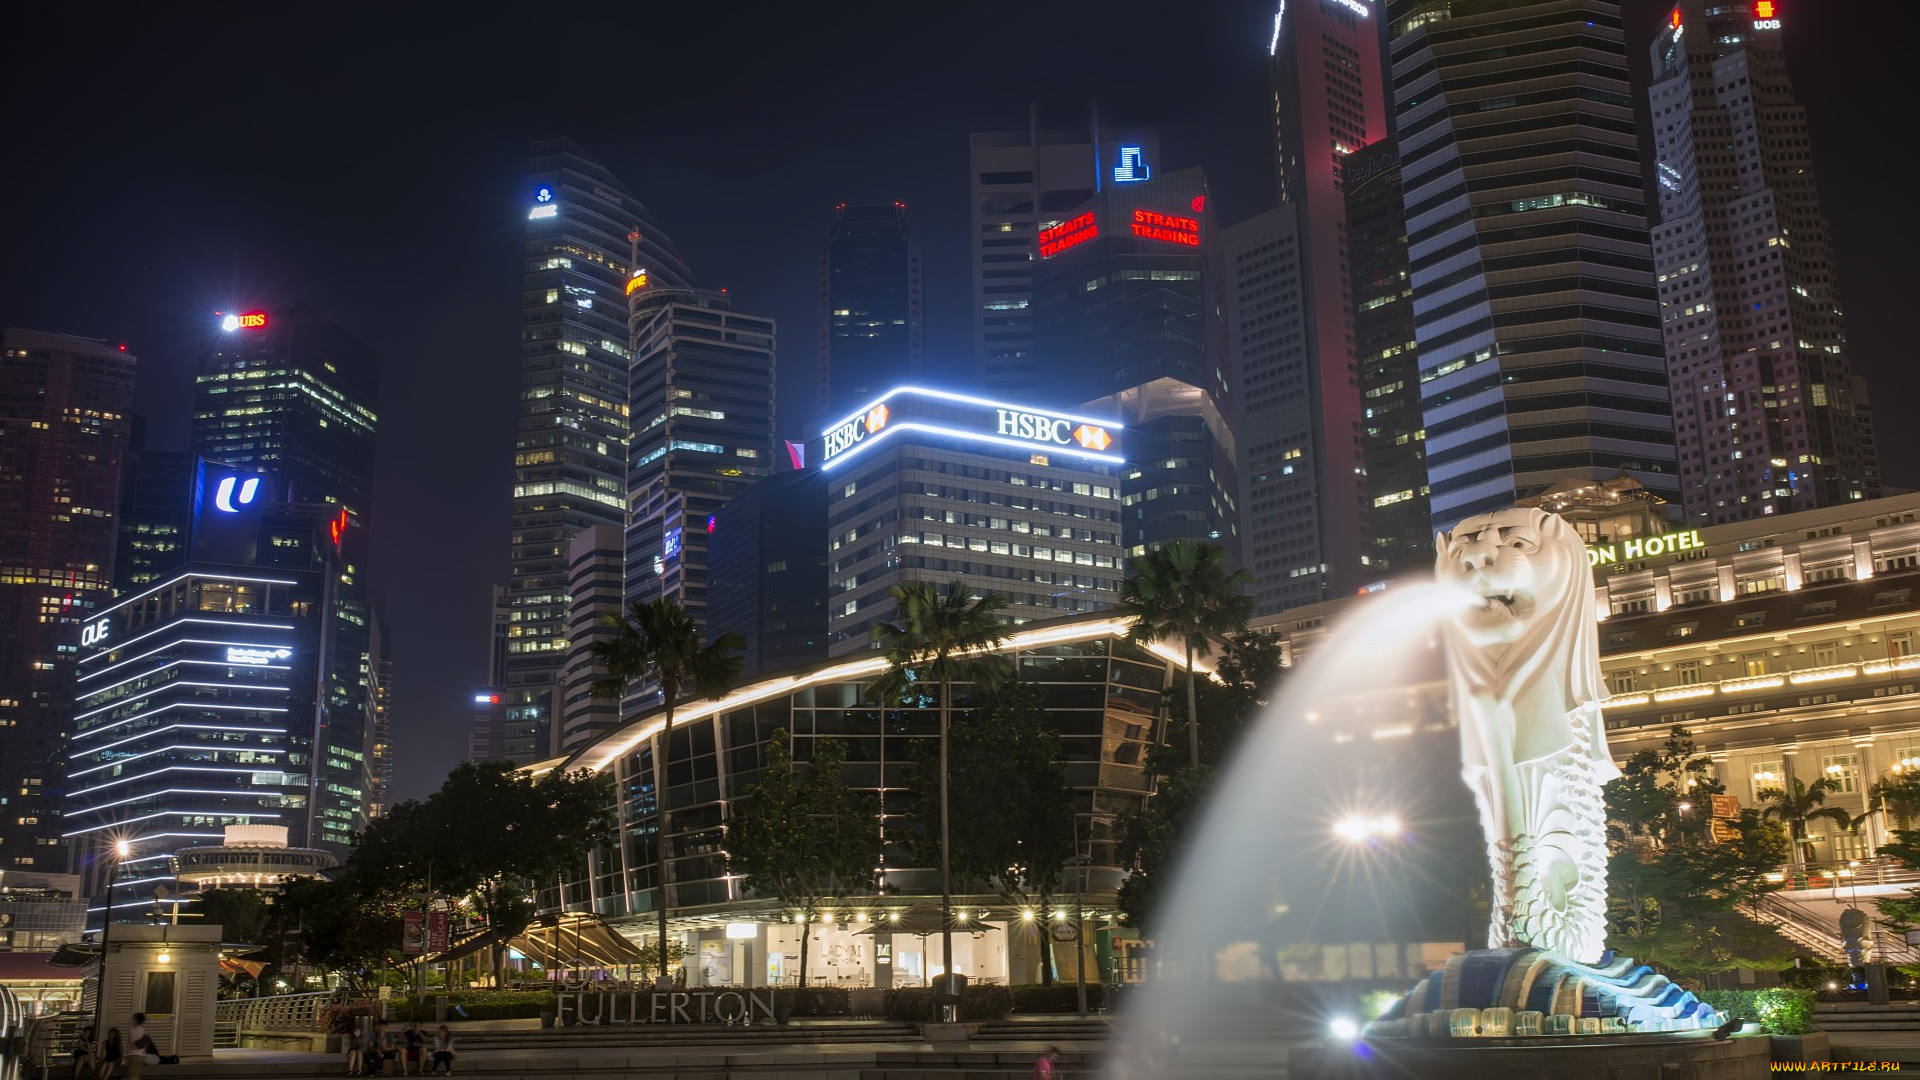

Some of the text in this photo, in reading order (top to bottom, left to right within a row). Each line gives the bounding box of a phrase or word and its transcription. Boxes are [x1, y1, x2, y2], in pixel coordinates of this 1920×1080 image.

[1753, 20, 1781, 29] UOB
[1039, 211, 1095, 244] STRAITS
[1131, 223, 1199, 246] TRADING
[1134, 210, 1199, 232] STRAITS
[1039, 225, 1098, 258] TRADING
[239, 314, 265, 328] UBS
[823, 415, 865, 460] HSBC
[997, 409, 1071, 444] HSBC
[1624, 530, 1704, 559] HOTEL
[81, 618, 110, 646] OUE
[821, 944, 862, 957] LADY M
[876, 944, 891, 956] M
[558, 990, 775, 1024] FULLERTON
